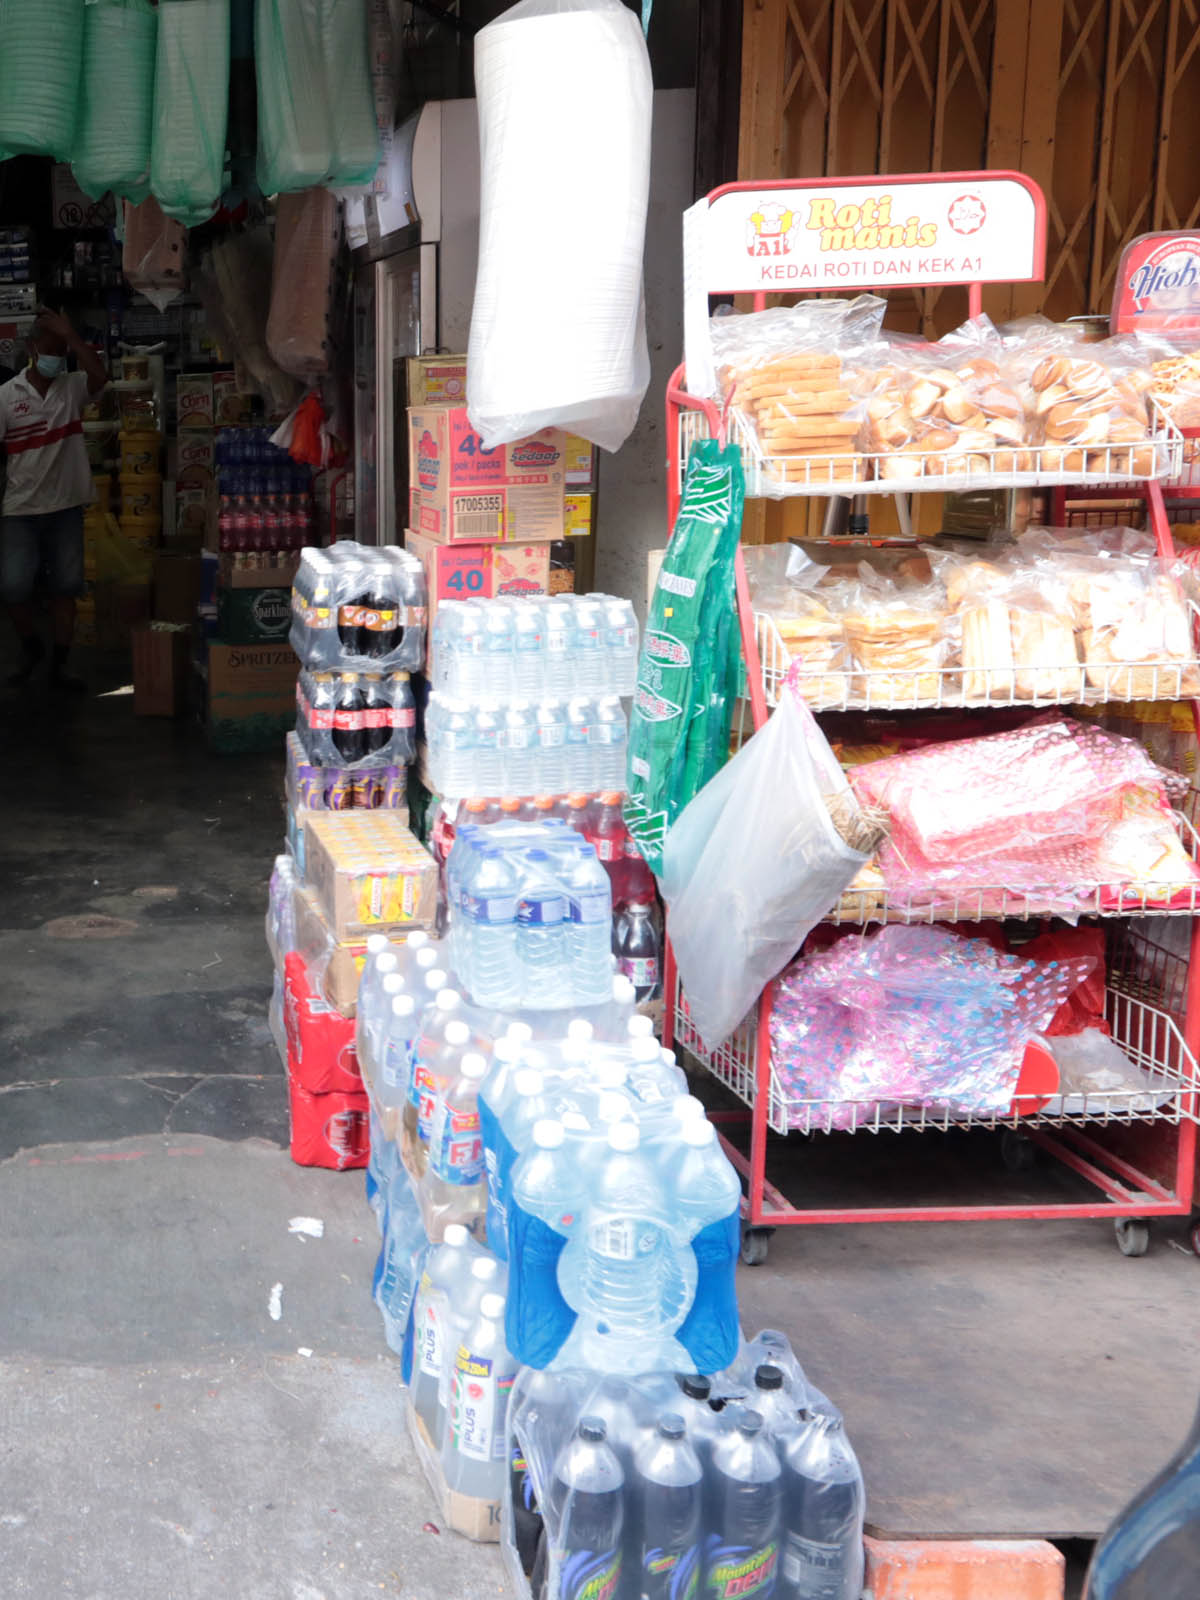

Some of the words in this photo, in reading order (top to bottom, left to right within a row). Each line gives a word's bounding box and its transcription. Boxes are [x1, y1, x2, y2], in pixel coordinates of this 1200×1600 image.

[806, 195, 892, 230] Roti
[756, 240, 783, 256] A1
[820, 217, 937, 251] manis
[761, 264, 817, 280] KEDAI
[824, 261, 867, 277] ROTI
[873, 260, 910, 275] DAN
[918, 258, 955, 273] KEK
[961, 257, 982, 271] A1
[455, 497, 500, 511] 17005355
[447, 570, 484, 591] 40
[425, 1327, 436, 1362] PLUS
[465, 1406, 477, 1442] PLUS
